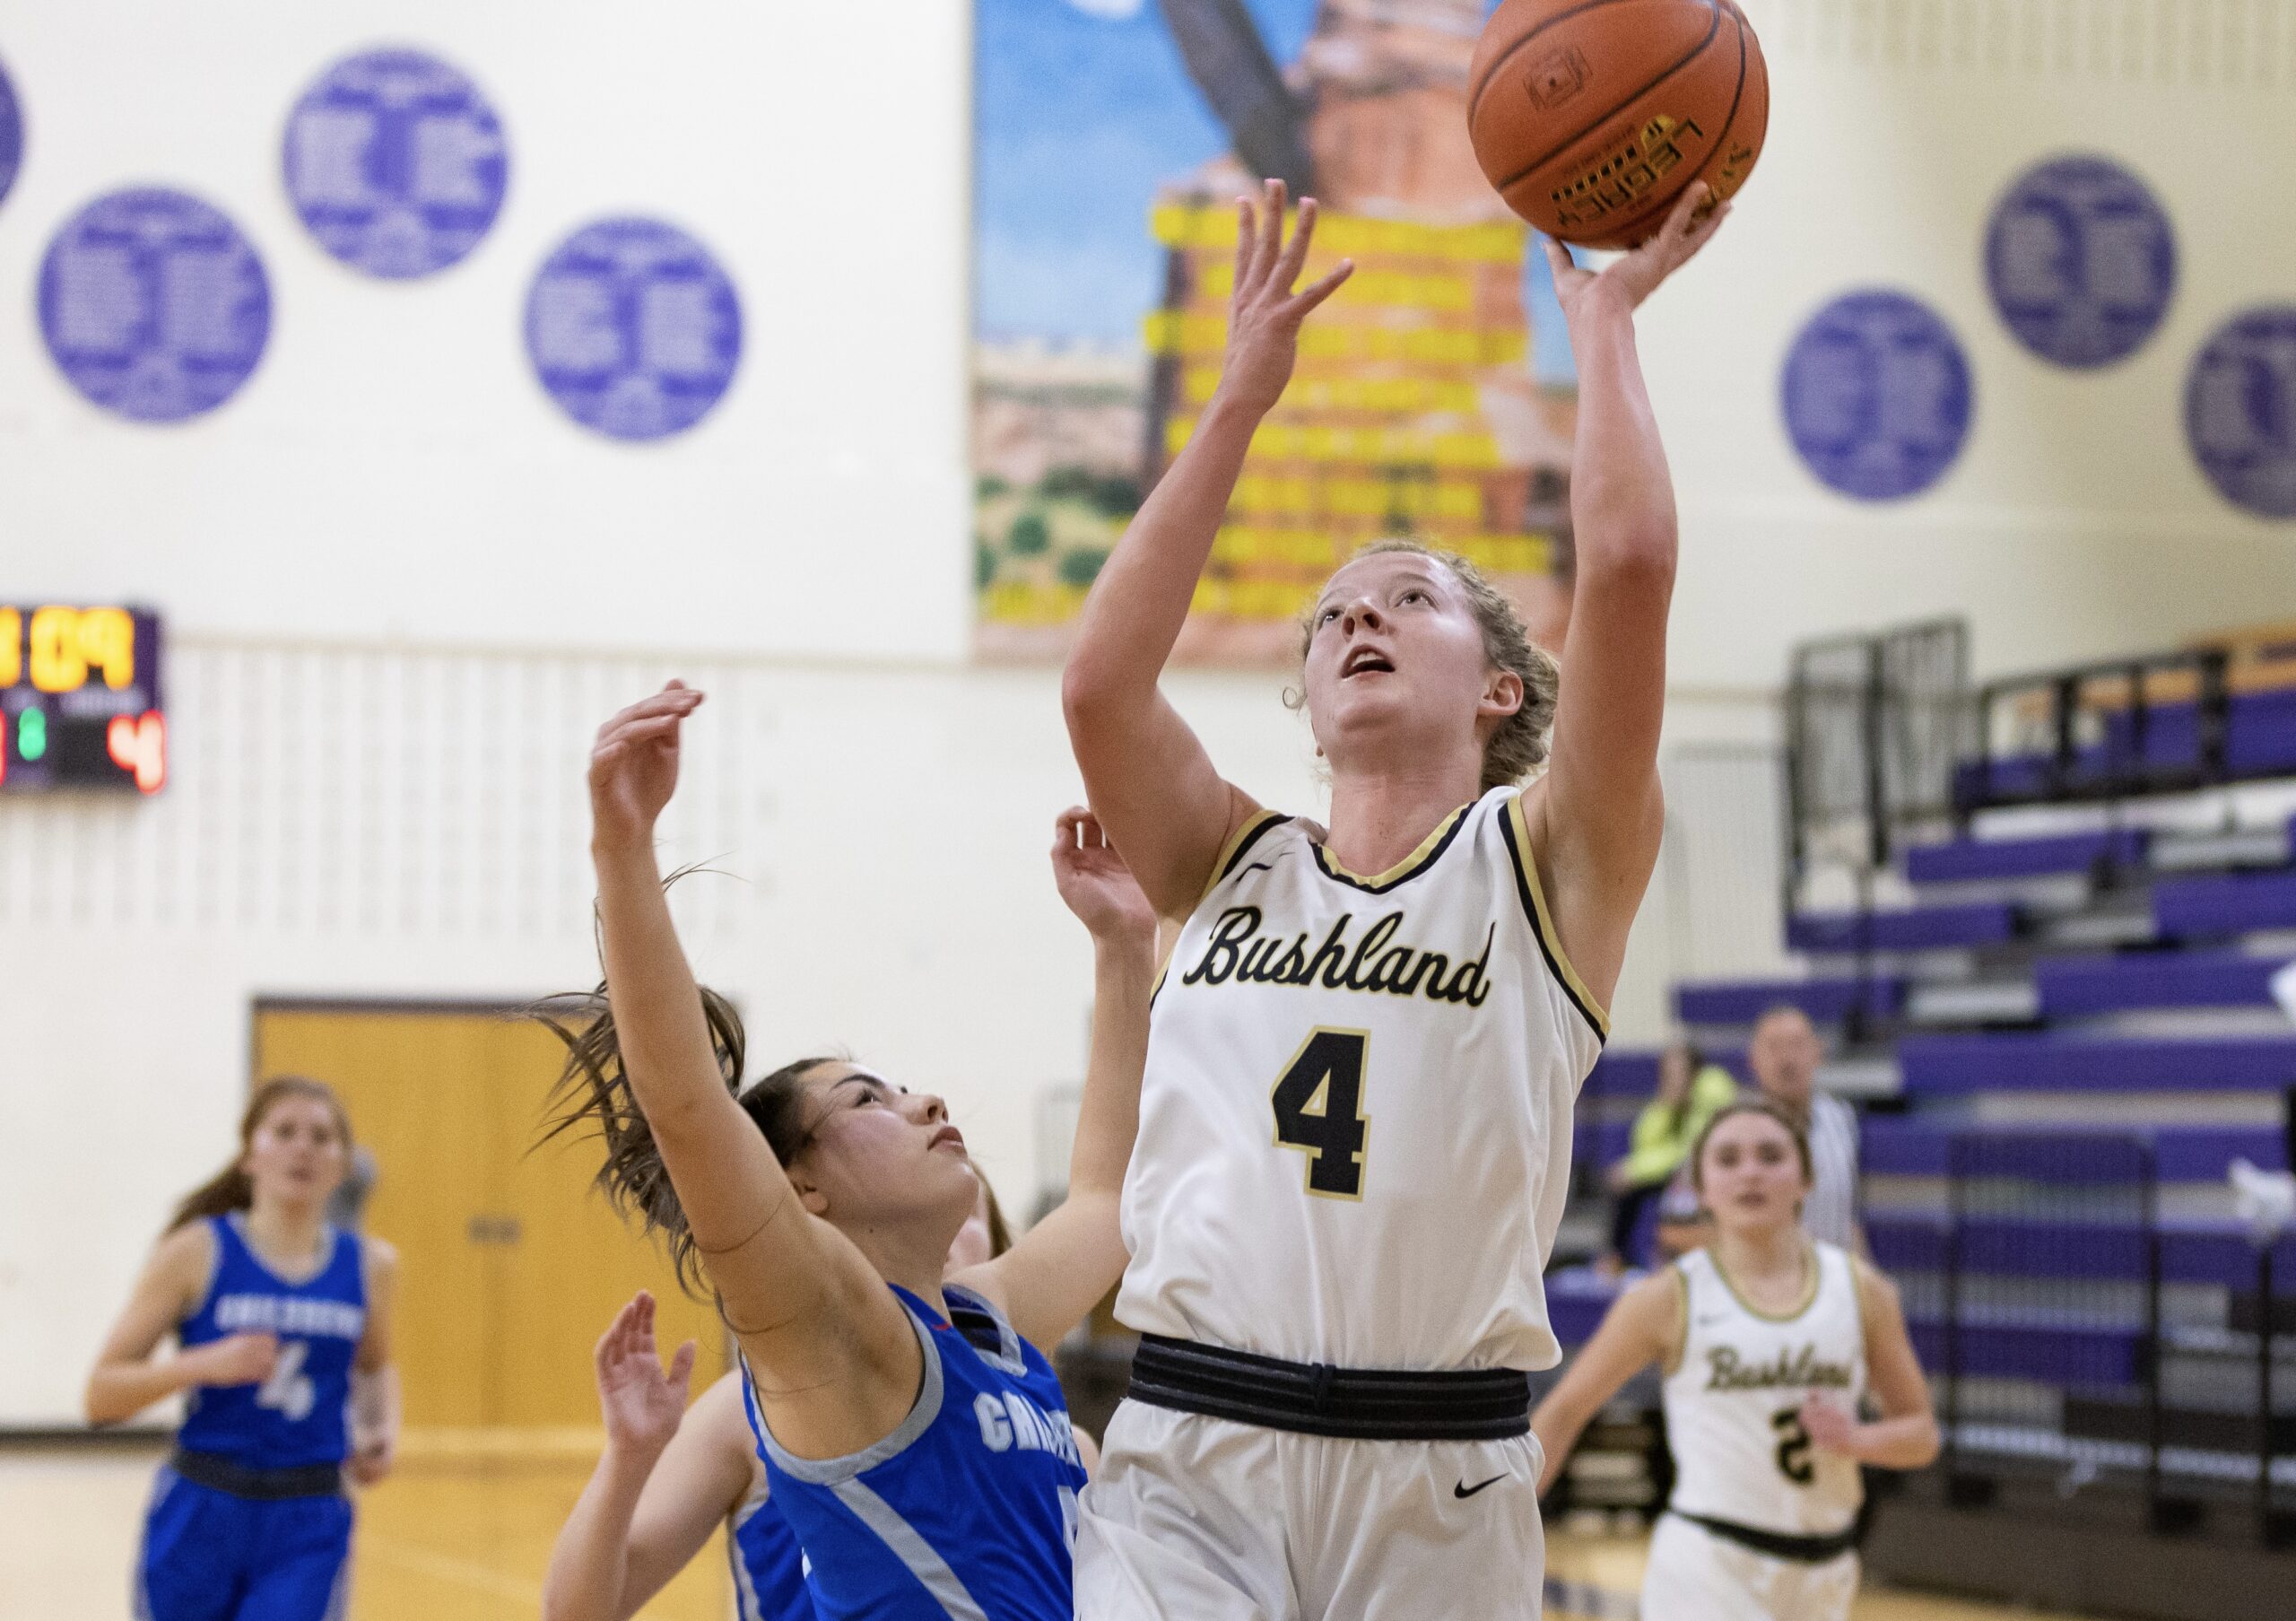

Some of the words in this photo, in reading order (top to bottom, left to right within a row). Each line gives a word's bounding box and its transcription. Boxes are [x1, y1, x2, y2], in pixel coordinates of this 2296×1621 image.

[1556, 116, 1704, 226] LEGACY
[1180, 904, 1497, 1008] Bushland
[1268, 1024, 1371, 1203] 4
[256, 1340, 314, 1421] 4
[1770, 1407, 1814, 1486] 2
